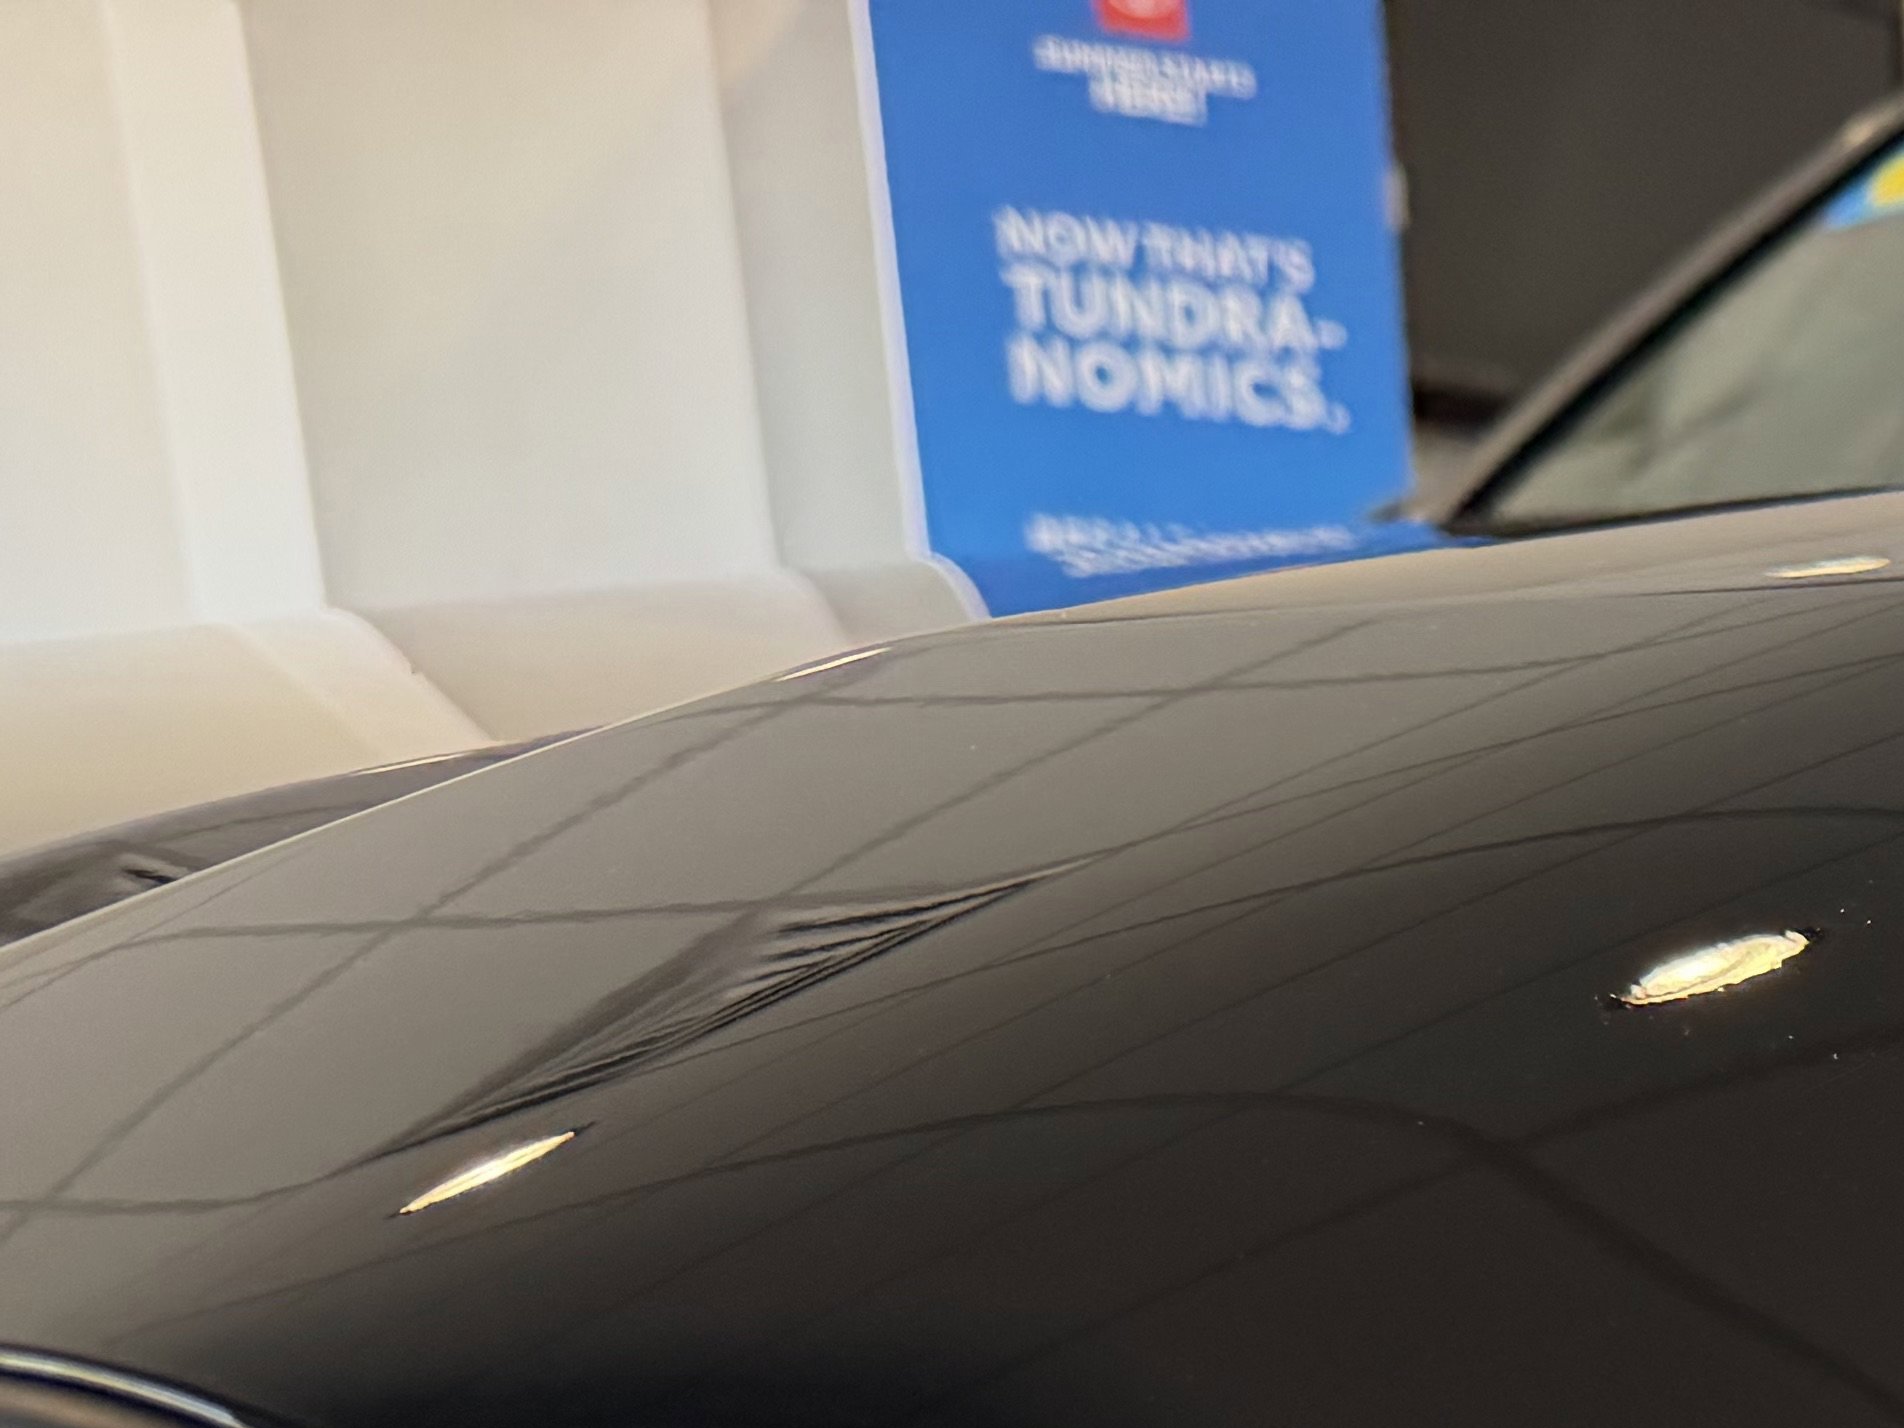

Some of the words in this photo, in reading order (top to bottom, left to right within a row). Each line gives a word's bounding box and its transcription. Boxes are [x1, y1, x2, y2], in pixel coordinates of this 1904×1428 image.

[994, 206, 1140, 270] NOW
[1142, 222, 1314, 294] THAT'S
[1003, 260, 1348, 352] TUNDRA-
[1007, 332, 1350, 434] NOMICS.
